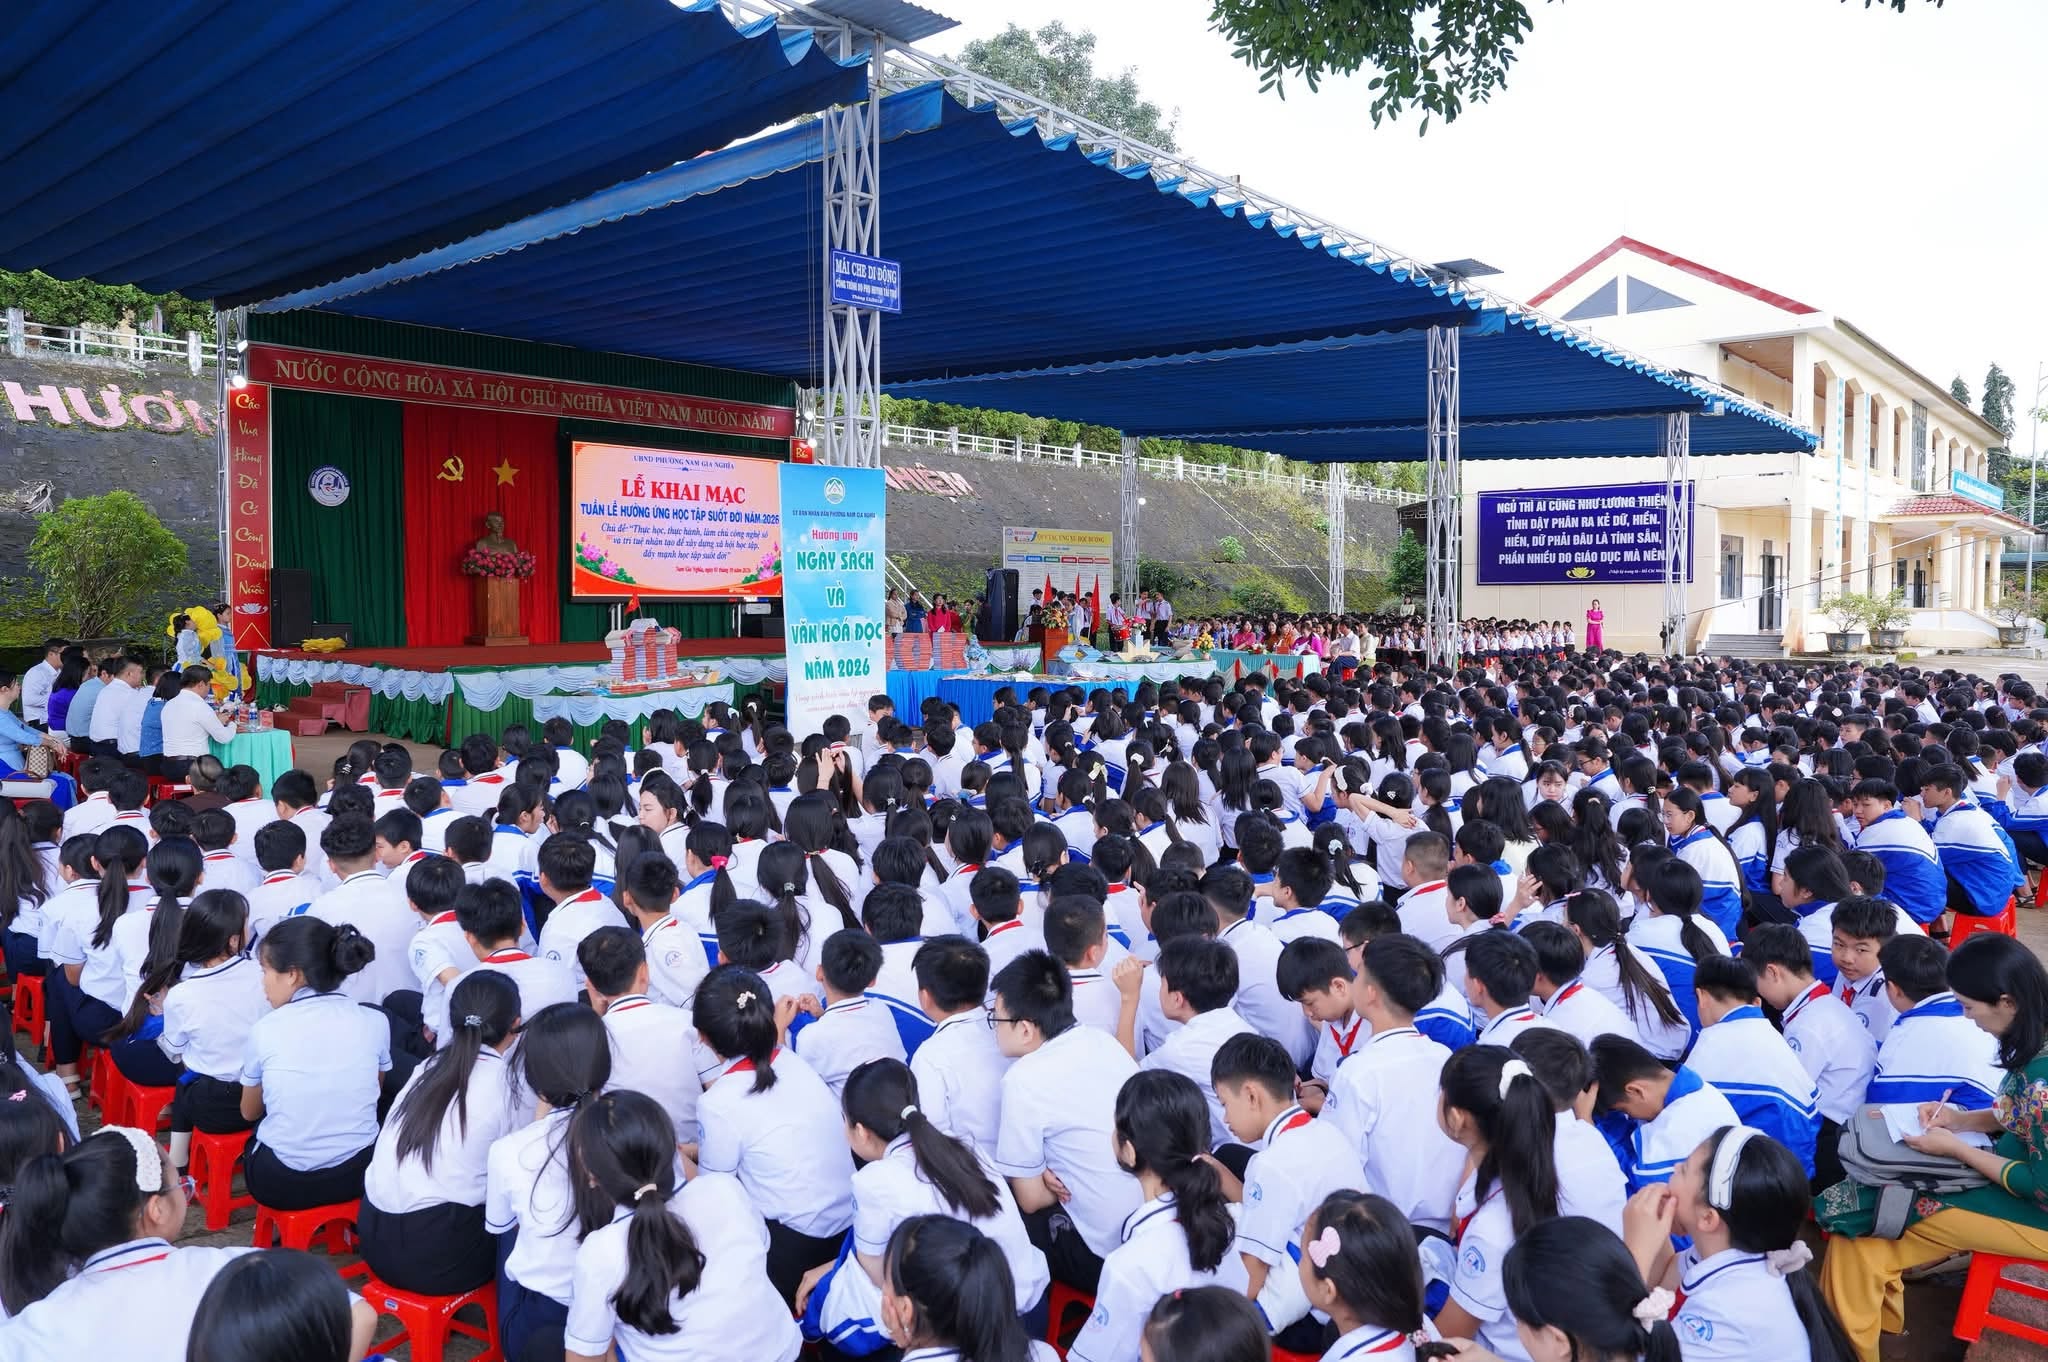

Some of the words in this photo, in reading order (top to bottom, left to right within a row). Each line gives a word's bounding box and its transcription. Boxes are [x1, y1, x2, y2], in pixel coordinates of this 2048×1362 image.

[836, 257, 850, 274] MÁI
[852, 263, 866, 278] CHE
[868, 266, 876, 280] DI
[878, 265, 896, 285] ĐỘNG
[236, 394, 260, 410] Các
[276, 358, 336, 384] NƯỚC
[344, 365, 400, 391] CỘNG
[406, 370, 446, 396] HÒA
[452, 378, 476, 398] XÃ
[482, 381, 515, 406] HỘI
[520, 384, 556, 407] CHỦ
[560, 391, 613, 414] NGHĨA
[618, 397, 654, 420] VIỆT
[658, 404, 690, 422] NAM
[696, 406, 738, 428] MUÔN
[742, 411, 776, 431] NĂM!
[239, 419, 258, 436] Vua
[234, 446, 262, 476] Hùng
[656, 456, 684, 464] PHƯỜNG
[622, 474, 646, 498] LỄ
[651, 481, 700, 500] KHAI
[706, 485, 746, 506] MẠC
[885, 462, 981, 502] HIỆN
[240, 500, 258, 516] Có
[580, 498, 604, 516] TUẦN
[653, 504, 670, 519] ỨNG
[672, 508, 690, 522] HỌC
[691, 507, 706, 523] TẬP
[708, 507, 728, 522] SUỐT
[1496, 499, 1516, 514] NGỦ
[1519, 500, 1534, 512] THÌ
[1536, 500, 1546, 512] AI
[1549, 498, 1576, 511] CŨNG
[1578, 498, 1600, 510] NHƯ
[1602, 496, 1635, 508] LƯƠNG
[1638, 493, 1667, 508] THIỆN
[1506, 516, 1528, 530] TỈNH
[1530, 516, 1549, 531] DẬY
[1552, 515, 1578, 528] PHÂN
[1582, 516, 1594, 528] RA
[1597, 512, 1610, 526] KẺ
[1612, 513, 1630, 527] DỮ,
[235, 527, 264, 555] Công
[1532, 534, 1546, 546] DỮ
[1548, 532, 1570, 546] PHẢI
[1573, 532, 1594, 545] ĐÂU
[1596, 532, 1608, 544] LÀ
[1610, 530, 1634, 544] TÍNH
[1637, 528, 1662, 544] SẴN,
[796, 545, 836, 570] NGÀY
[840, 546, 874, 570] SÁCH
[1558, 552, 1572, 563] DO
[1574, 550, 1598, 562] GIÁO
[1600, 551, 1621, 564] DỤC
[1624, 548, 1640, 562] MÀ
[827, 581, 844, 606] VÀ
[791, 619, 818, 644] VĂN
[822, 618, 850, 642] HOÁ
[855, 622, 882, 648] ĐỌC
[804, 655, 834, 680] NĂM
[838, 658, 870, 678] 2026
